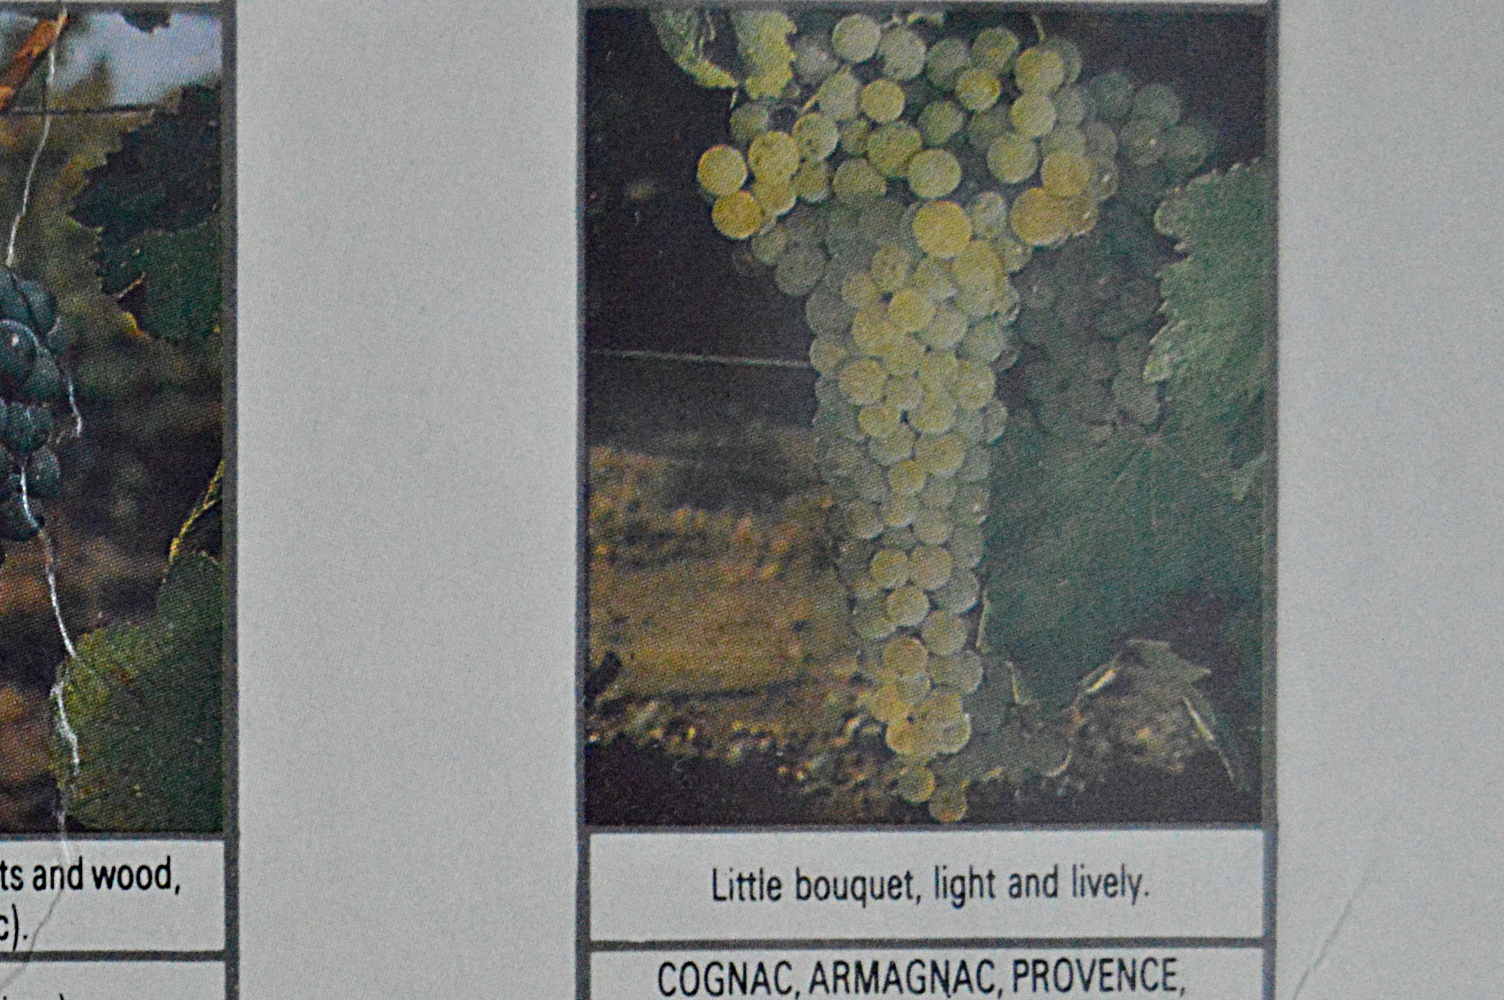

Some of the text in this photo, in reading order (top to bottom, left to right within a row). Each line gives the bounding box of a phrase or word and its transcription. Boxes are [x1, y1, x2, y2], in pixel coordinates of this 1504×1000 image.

[32, 855, 84, 892] and
[90, 854, 181, 896] wood,
[711, 863, 1150, 910] Little bouquet, light and lively.
[657, 956, 1186, 1000] COGNAC, ARMAGNAC, PROVENCE,
